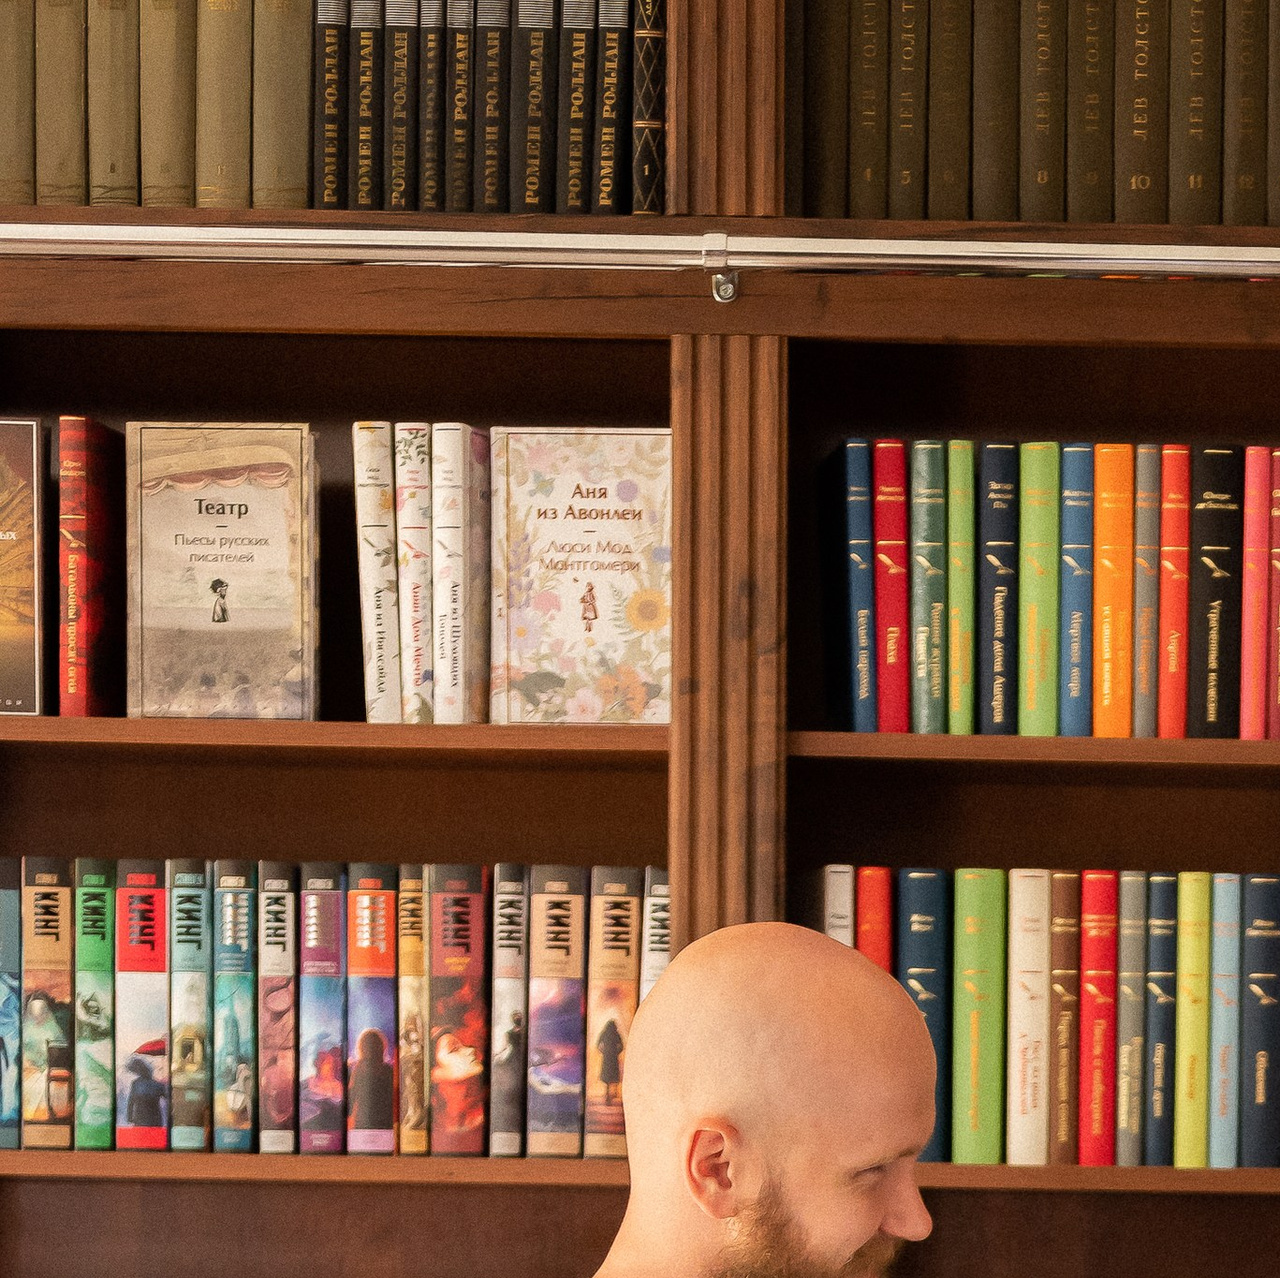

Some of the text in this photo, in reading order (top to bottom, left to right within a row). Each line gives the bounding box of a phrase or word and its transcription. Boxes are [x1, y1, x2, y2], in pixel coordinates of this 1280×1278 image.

[1134, 0, 1149, 81] ТОЛСТ
[599, 32, 619, 207] РОМЕН РОЛЛАН
[358, 126, 372, 206] РОМЕН
[1131, 174, 1151, 190] 10
[194, 498, 249, 519] Театр
[537, 504, 644, 520] из Авонлеи
[571, 483, 608, 500] Аня
[174, 533, 270, 549] Пьесы русских
[189, 550, 255, 563] писателей
[538, 557, 641, 573] Монтгомери
[544, 540, 633, 555] Люси Мод
[33, 891, 60, 942] КИНГ
[81, 891, 107, 941] КИНГ
[128, 894, 155, 951] КИНГ
[176, 894, 202, 951] КИНГ
[264, 895, 287, 952] КИНГ
[442, 896, 471, 954] КИНГ
[497, 899, 523, 956] КИНГ
[546, 899, 572, 956] КИНГ
[603, 900, 631, 957] КИНГ
